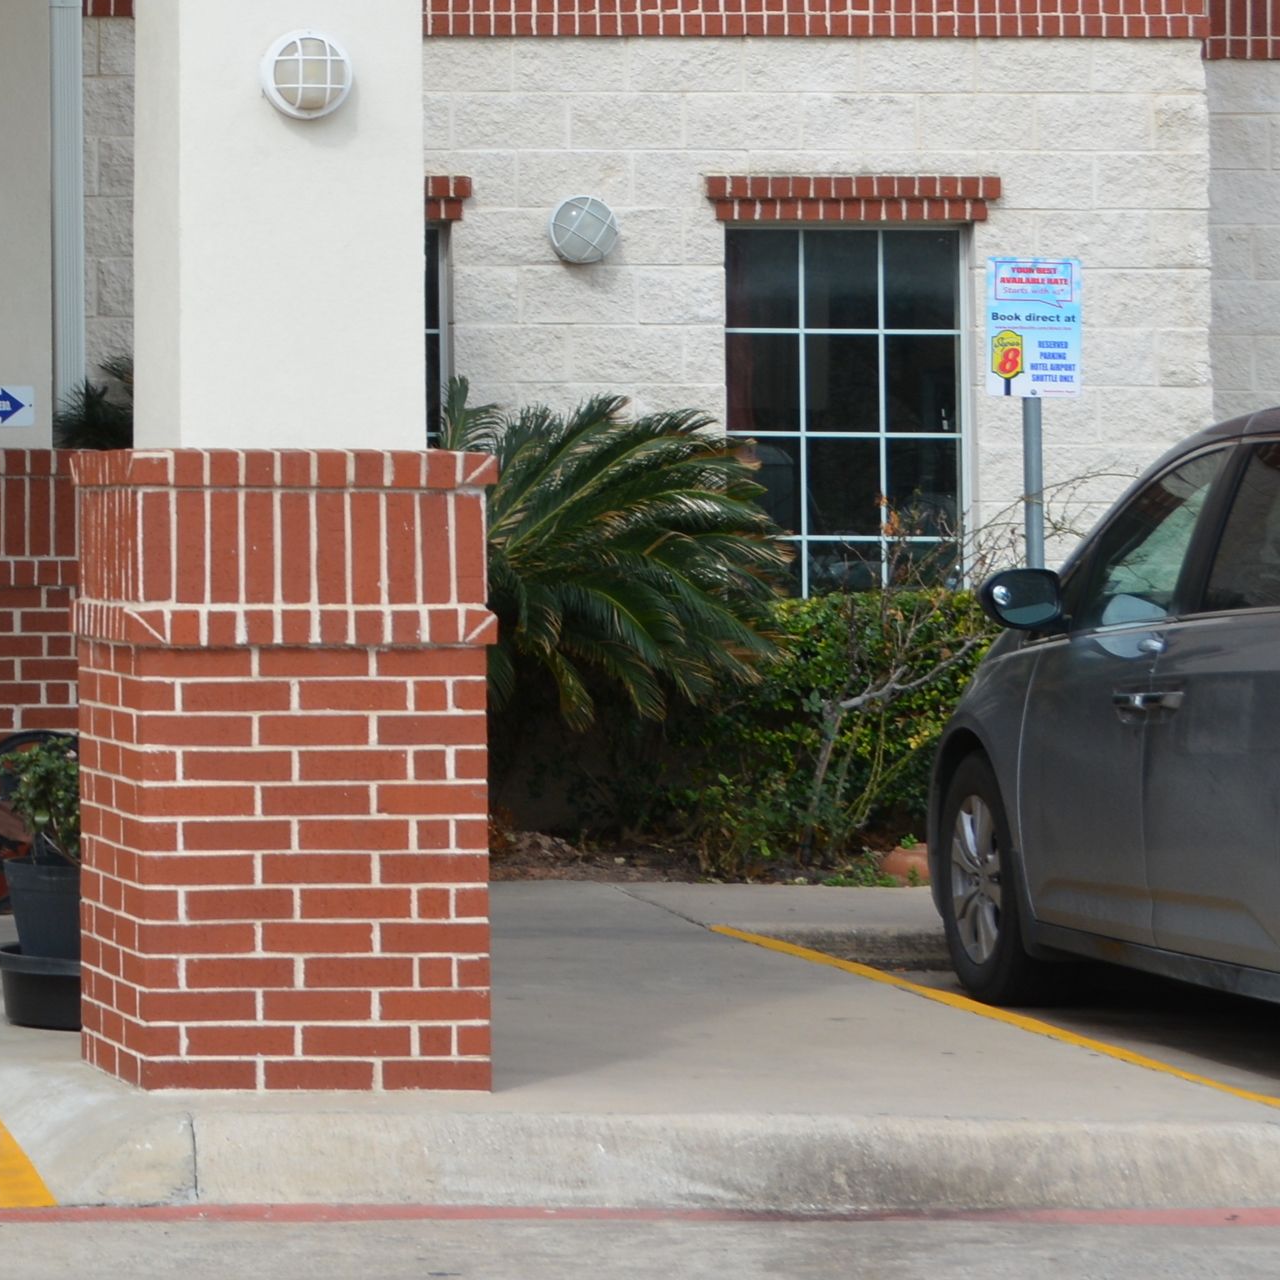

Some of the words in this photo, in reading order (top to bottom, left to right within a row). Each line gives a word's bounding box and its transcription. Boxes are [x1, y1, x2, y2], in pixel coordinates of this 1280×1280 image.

[1000, 277, 1045, 285] AVAILABLE
[991, 312, 1022, 321] Book
[1025, 313, 1060, 322] direct
[993, 336, 1020, 352] Super
[1038, 340, 1068, 349] RESERVED
[998, 347, 1020, 374] 8
[1040, 352, 1066, 360] PARKING
[1030, 362, 1048, 371] HOTEL
[1050, 363, 1076, 371] AIRPORT
[1032, 374, 1057, 382] SHUTTLE
